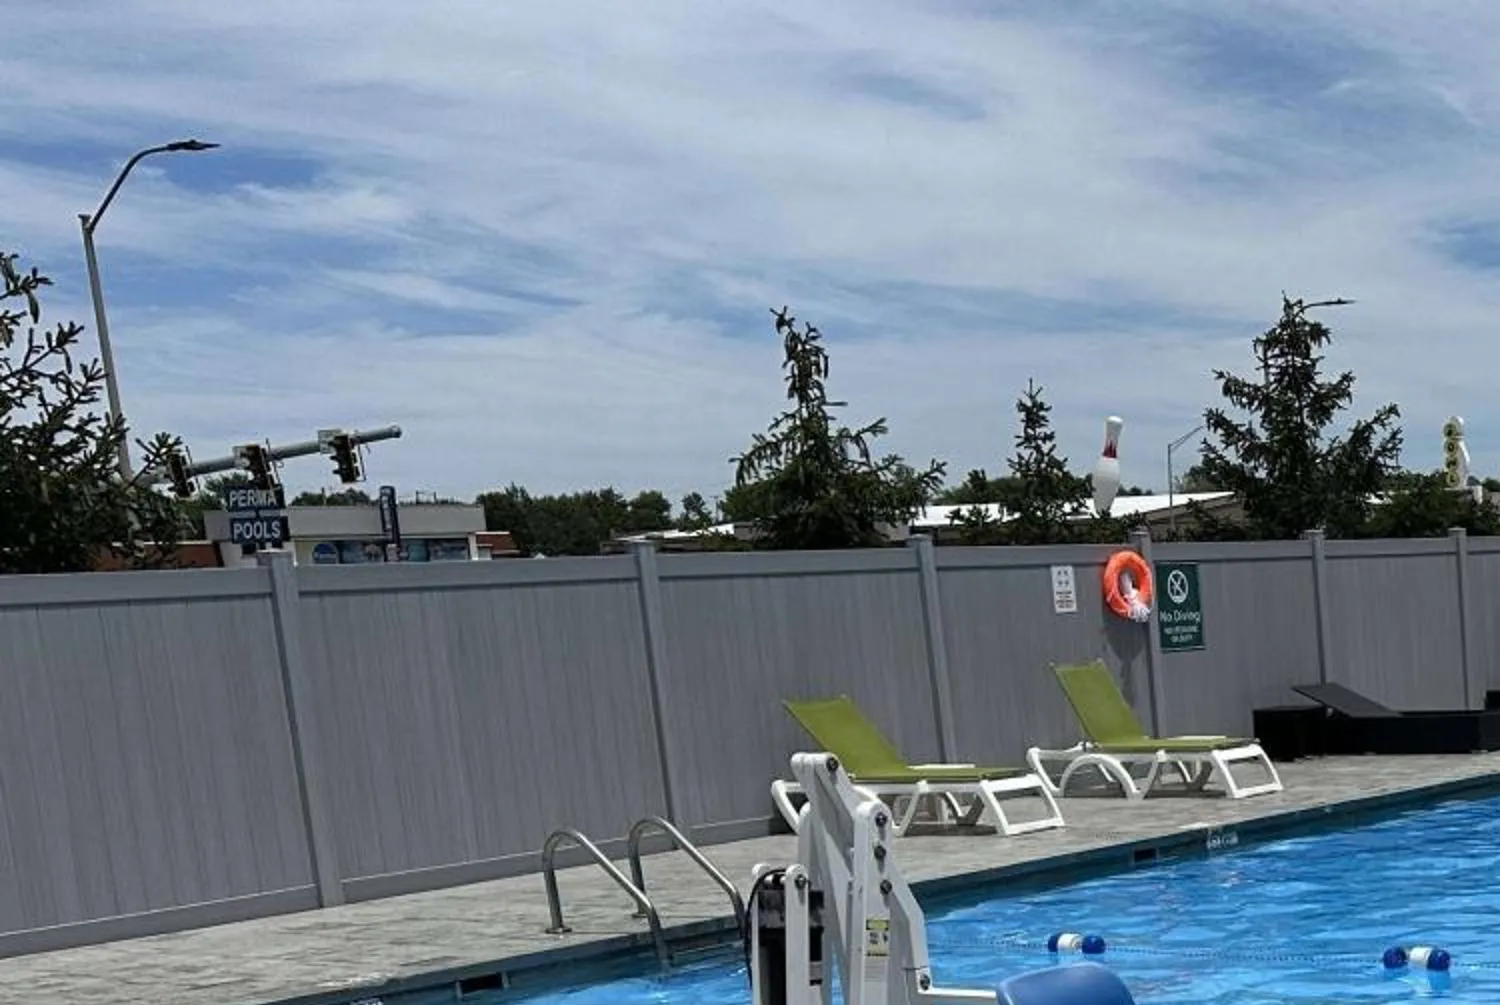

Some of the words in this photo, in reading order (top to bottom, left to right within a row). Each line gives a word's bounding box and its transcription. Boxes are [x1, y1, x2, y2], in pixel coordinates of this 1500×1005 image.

[229, 489, 277, 508] PERMA
[233, 520, 281, 541] POOLS
[1160, 611, 1172, 623] No
[1174, 609, 1201, 624] Diving
